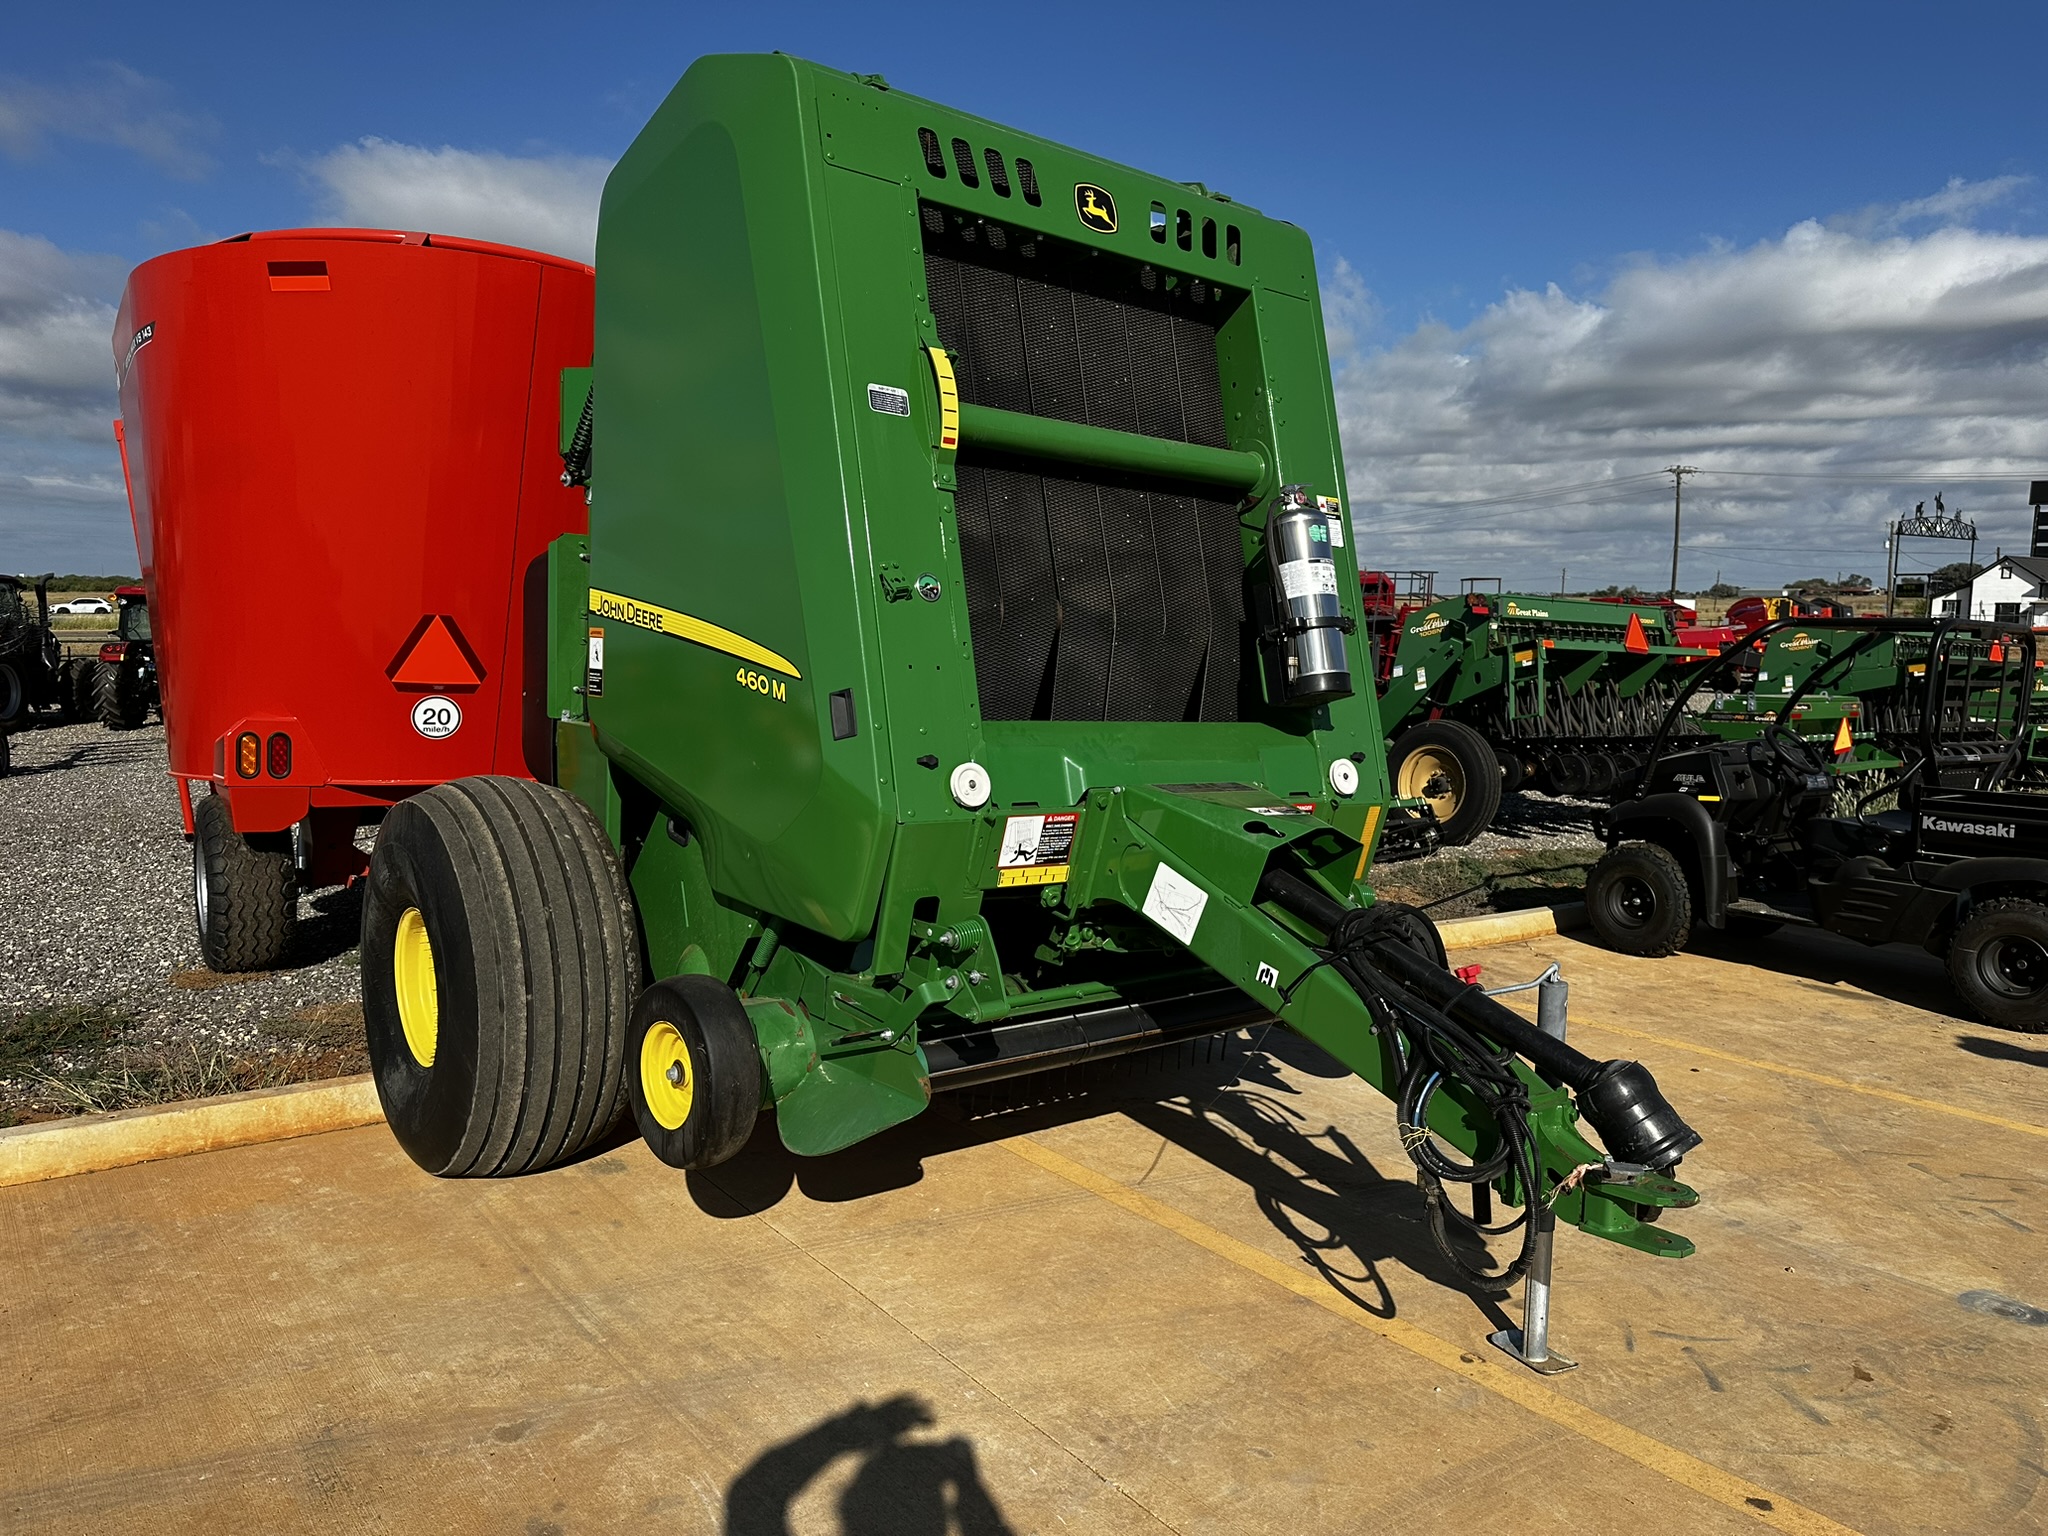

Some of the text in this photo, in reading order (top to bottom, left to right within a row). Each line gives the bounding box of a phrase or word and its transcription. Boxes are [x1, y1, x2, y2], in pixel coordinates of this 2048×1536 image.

[142, 326, 152, 340] 143
[596, 595, 664, 630] JOHN DEERE
[1515, 607, 1549, 618] Great Plains
[1410, 624, 1432, 634] Great
[736, 667, 786, 702] 460 M
[422, 708, 451, 725] 20
[1922, 815, 2016, 839] Kawasaki
